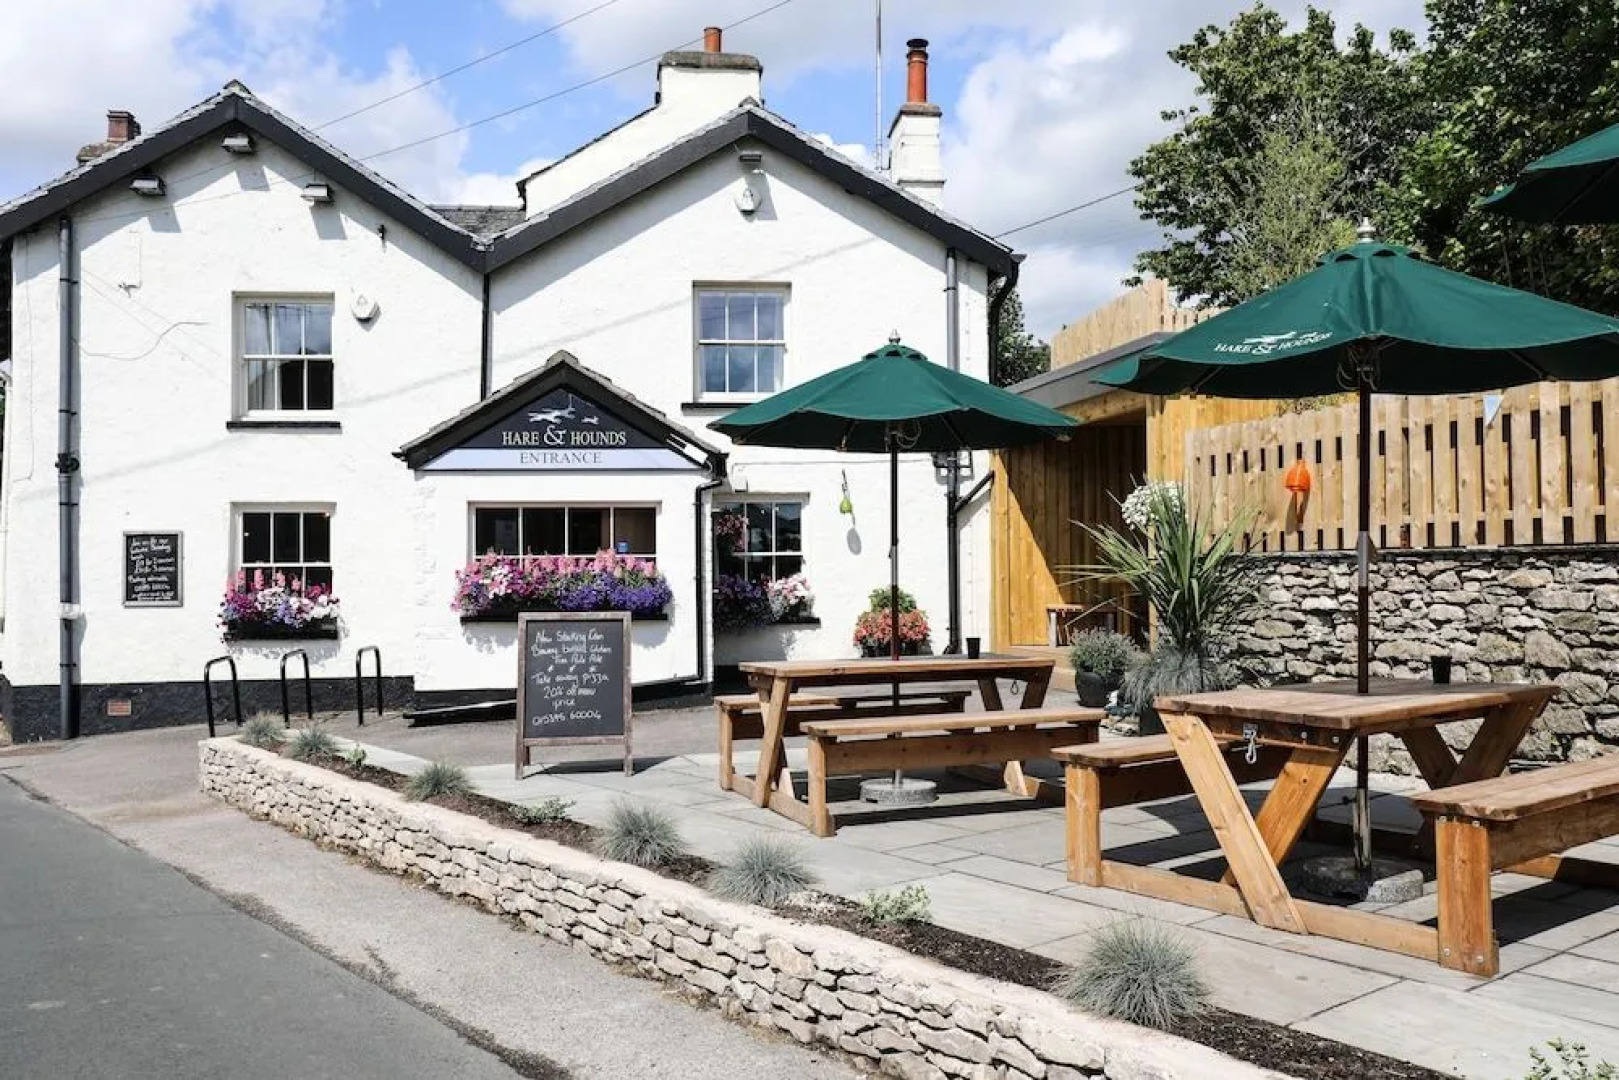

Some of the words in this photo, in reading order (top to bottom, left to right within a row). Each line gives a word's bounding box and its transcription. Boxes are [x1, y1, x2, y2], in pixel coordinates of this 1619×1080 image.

[1214, 343, 1252, 354] HARE
[1252, 344, 1278, 355] &
[502, 431, 540, 446] HARE
[543, 425, 567, 446] &
[570, 431, 627, 446] HOUNDS
[520, 452, 604, 465] ENTRANCE
